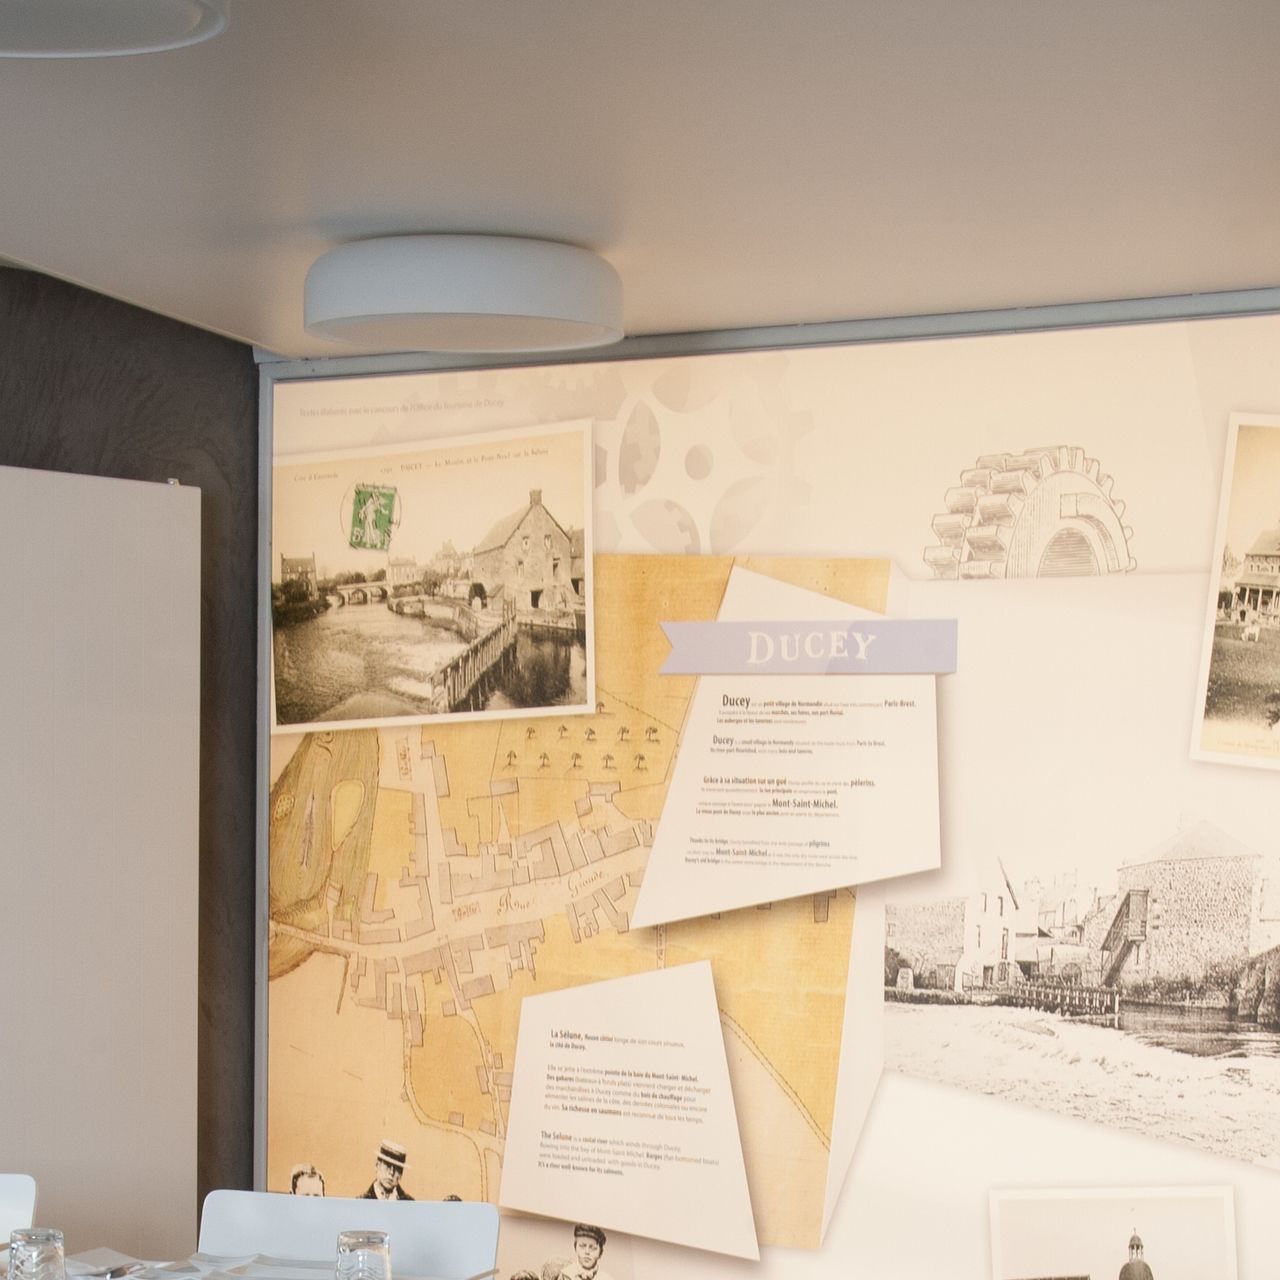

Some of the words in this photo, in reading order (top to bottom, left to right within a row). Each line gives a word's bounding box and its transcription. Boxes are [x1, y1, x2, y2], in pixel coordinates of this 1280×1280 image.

[746, 631, 877, 664] DUCEY
[722, 694, 751, 710] Ducey
[712, 735, 735, 747] Ducey
